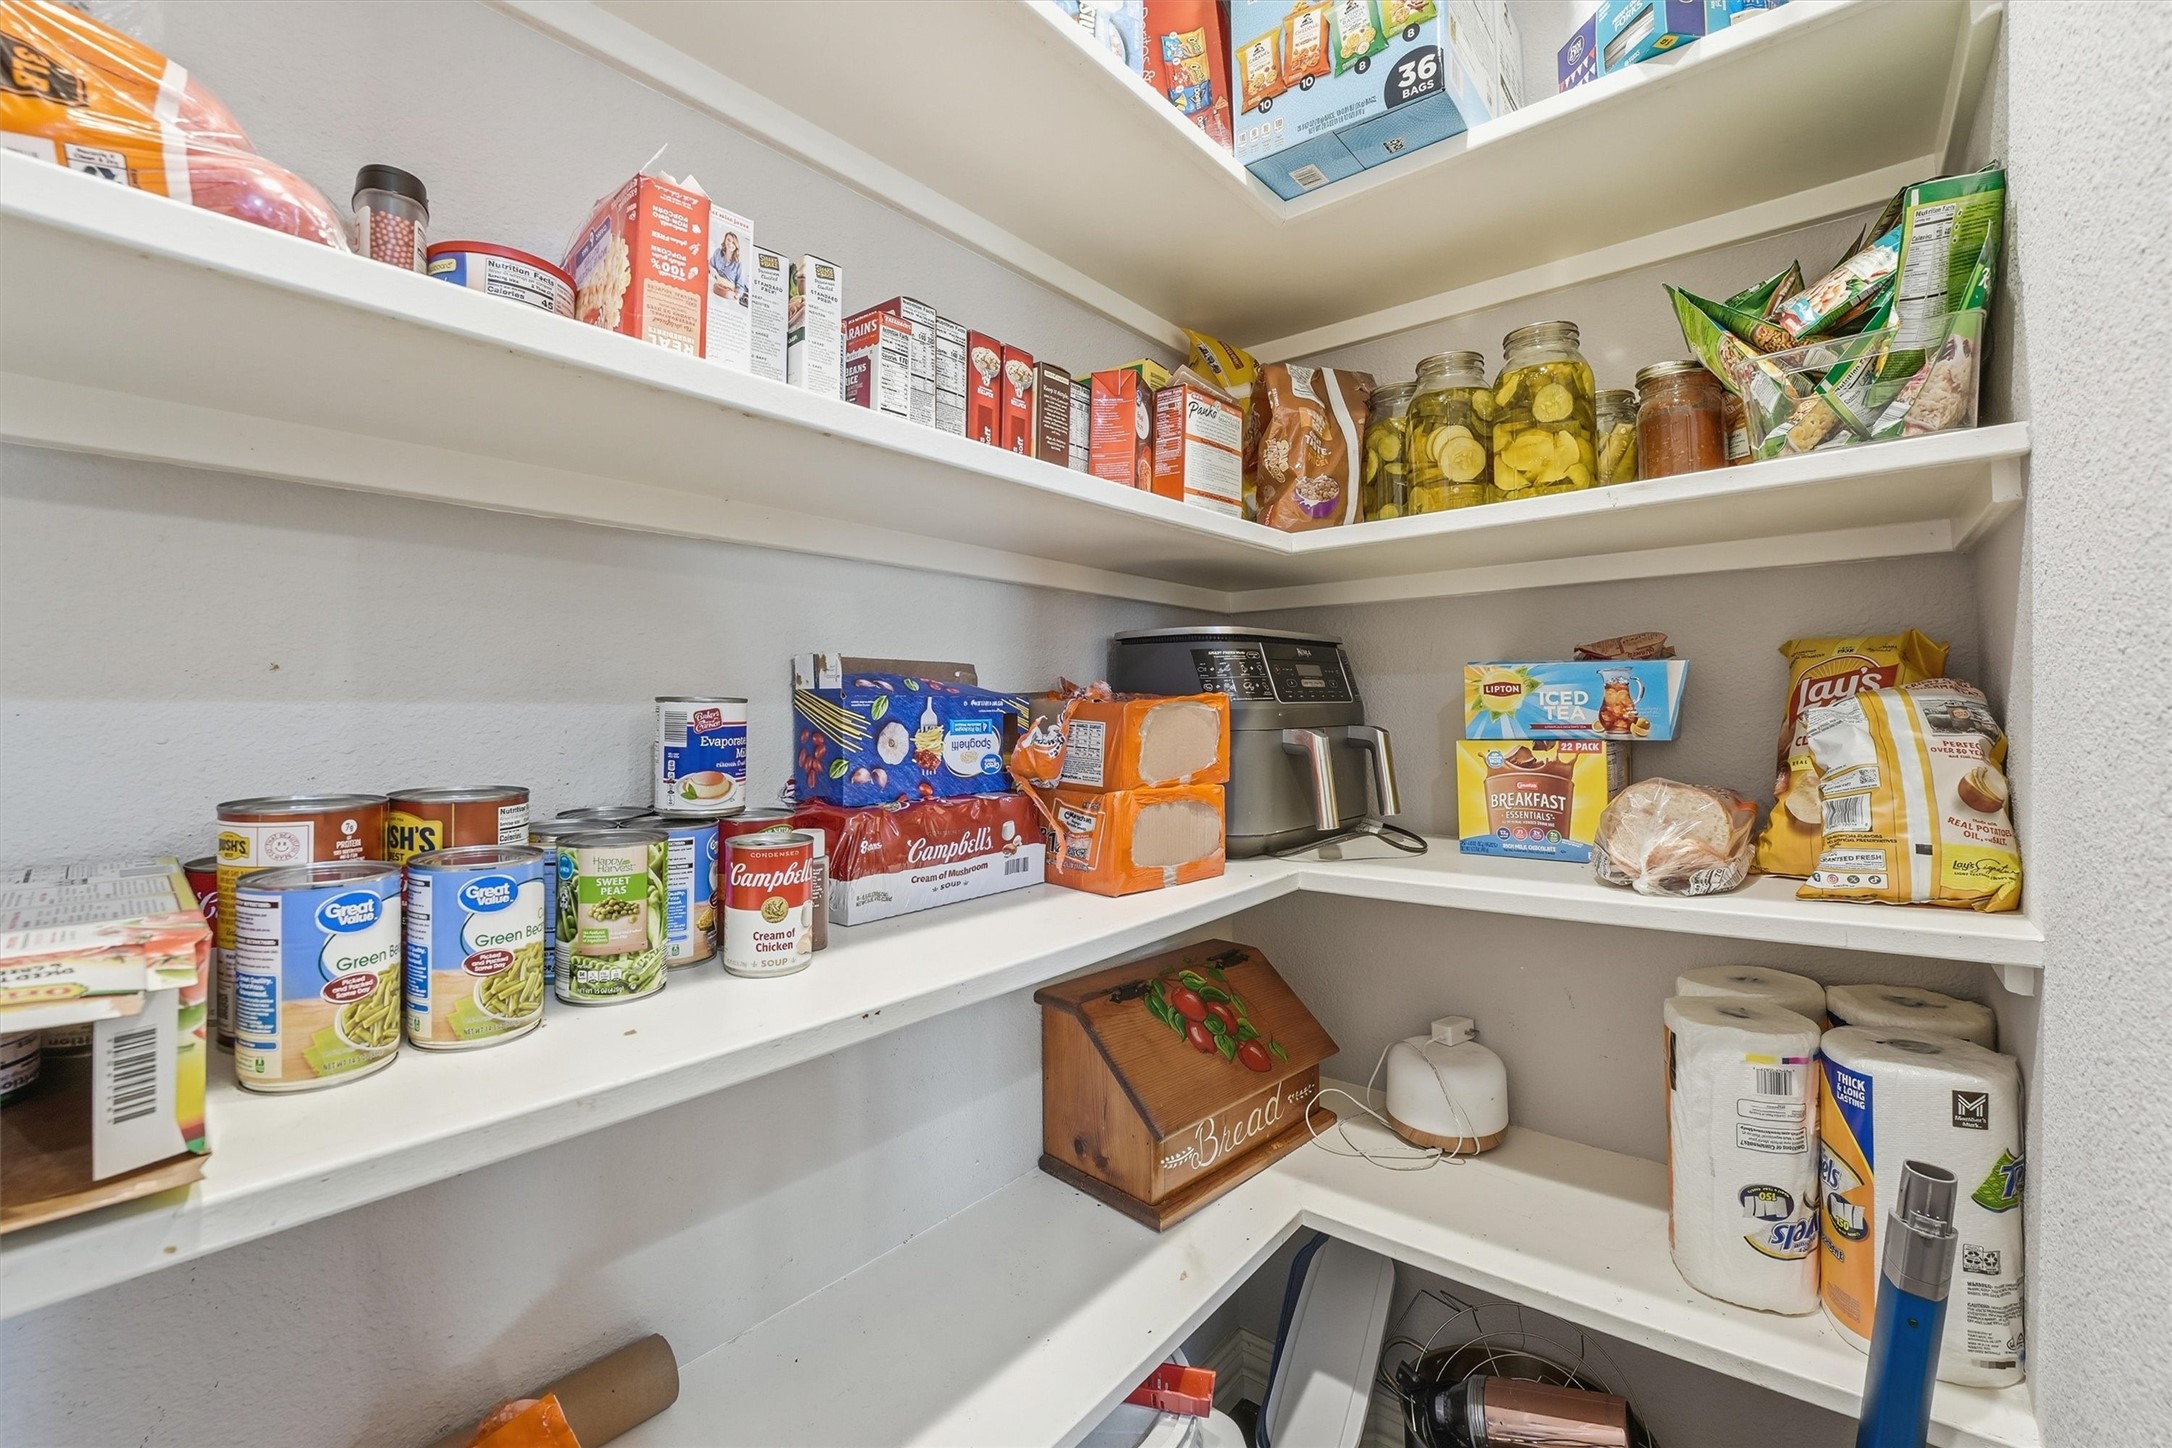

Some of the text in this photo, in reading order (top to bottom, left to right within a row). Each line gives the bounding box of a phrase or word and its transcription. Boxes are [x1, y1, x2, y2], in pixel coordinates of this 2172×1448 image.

[1615, 1, 1643, 32] FORKS
[1141, 6, 1152, 66] Doritos
[1407, 28, 1415, 38] 8
[1359, 61, 1367, 71] 8
[1398, 54, 1437, 87] 36
[1301, 76, 1314, 88] 10
[1402, 80, 1435, 99] BAGS
[1260, 100, 1272, 111] 10
[1915, 208, 1941, 217] Nutrition
[488, 260, 530, 276] Nutrition
[533, 272, 554, 287] Facts
[651, 258, 687, 277] 100%
[754, 279, 784, 293] STANDARD
[487, 286, 554, 310] Calories 45
[810, 289, 839, 304] STANDARD
[648, 333, 695, 357] REAL
[1188, 401, 1217, 419] Panko
[1485, 685, 1520, 694] LIPTON
[1800, 667, 1883, 716] Lay's
[1539, 691, 1589, 706] ICED
[1543, 706, 1586, 721] TEA
[951, 738, 992, 751] Spaghetti
[1561, 742, 1599, 751] 22 PACK
[1943, 740, 1981, 751] PERFEC
[1969, 749, 1985, 757] YEA
[1491, 792, 1566, 811] BREAKFAST
[1506, 811, 1551, 821] ESSENTIALS
[1948, 817, 1973, 830] REAL
[1963, 831, 1984, 843] OIL,
[336, 839, 362, 849] PROTEIN
[861, 840, 868, 854] 8
[907, 826, 993, 863] Campbell's
[751, 851, 800, 859] CONDENSED
[1855, 854, 1882, 862] FRESH
[593, 857, 623, 868] Happy
[597, 863, 633, 873] Harvest
[1952, 860, 1976, 871] Lay's
[911, 862, 989, 884] Cream of Mushroom
[596, 876, 631, 886] SWEET
[940, 880, 962, 891] SOUP
[465, 883, 510, 900] Great
[600, 886, 627, 895] PEAS
[325, 900, 374, 920] Great
[475, 931, 523, 948] Green
[753, 928, 795, 941] Cream of
[755, 941, 794, 953] Chicken
[336, 950, 387, 972] Green
[471, 955, 509, 968] and Packed
[479, 952, 502, 962] Picked
[761, 958, 788, 967] SOUP
[474, 961, 507, 973] Same Day
[332, 980, 374, 995] and Packed
[341, 975, 366, 987] Picked
[335, 987, 371, 999] Same Day
[322, 1063, 336, 1071] NET
[1837, 1071, 1866, 1092] THICK
[1837, 1083, 1866, 1101] & LONG
[1837, 1092, 1866, 1110] LASTING
[1191, 1081, 1286, 1169] Bread
[1759, 1192, 1777, 1201] 150
[1836, 1215, 1849, 1231] 150
